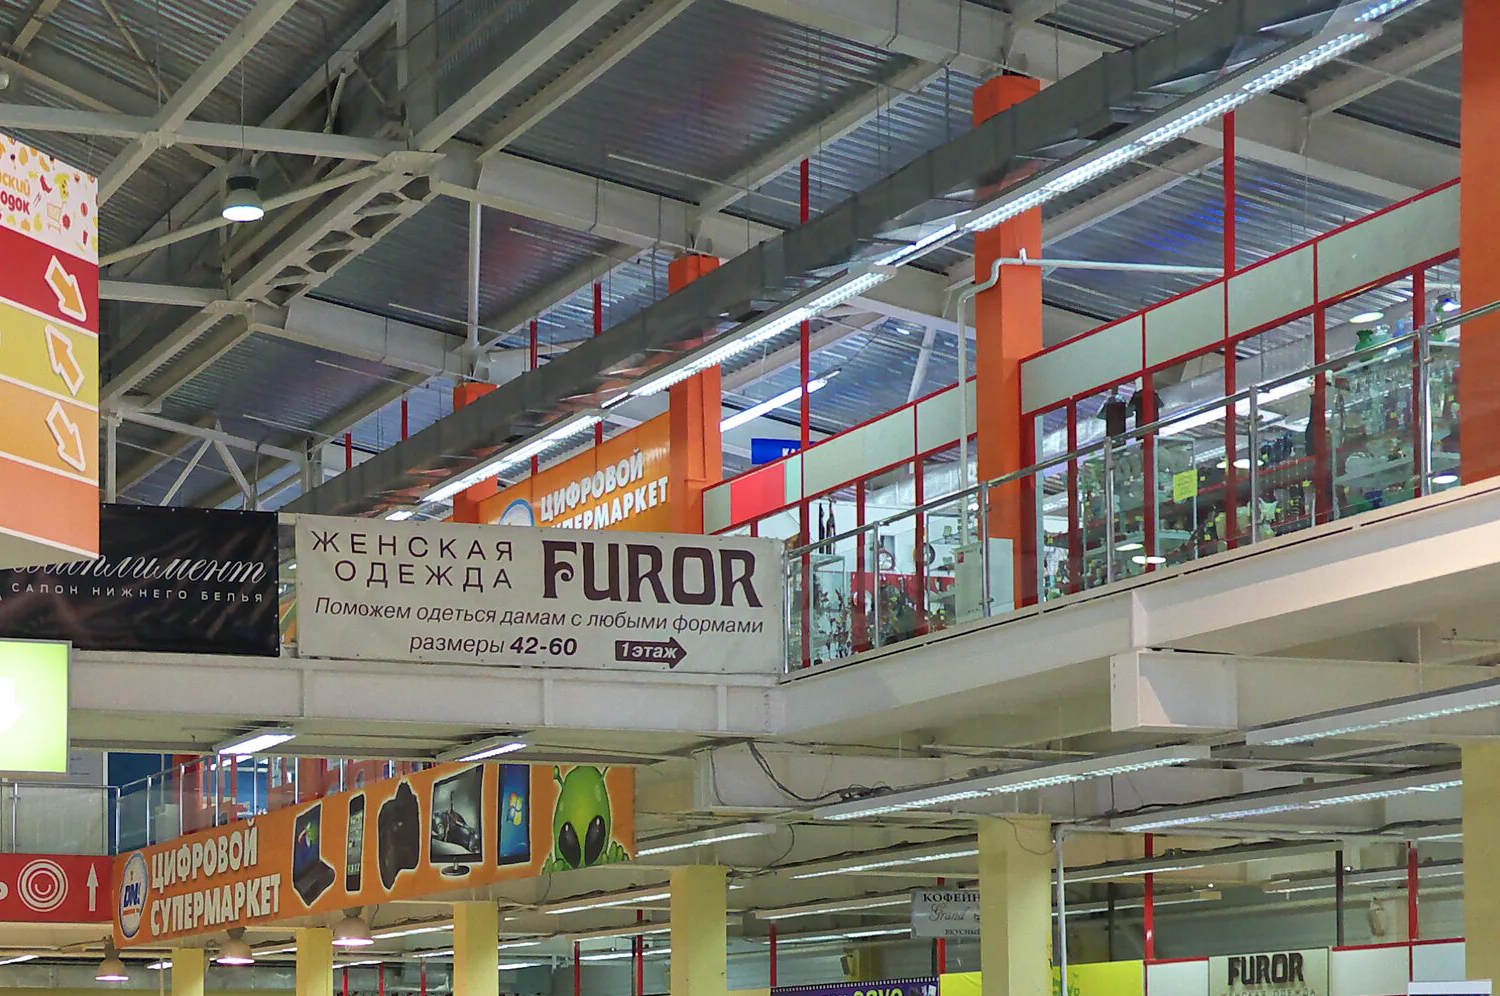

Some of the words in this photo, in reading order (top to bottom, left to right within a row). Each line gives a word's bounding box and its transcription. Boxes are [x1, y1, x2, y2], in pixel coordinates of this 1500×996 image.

[541, 448, 645, 522] ЦИФРОВОЙ
[311, 530, 514, 563] ЖЕНСКАЯ
[334, 559, 513, 593] ОДЕЖДА
[541, 539, 764, 609] FUROR
[11, 582, 79, 595] САЛОН
[92, 586, 188, 600] НИЖНЕГО
[201, 591, 263, 603] БЕЛЬЯ
[315, 597, 411, 620] Поможем
[416, 605, 497, 624] одеться
[500, 610, 566, 629] дамам
[571, 614, 583, 626] с
[586, 612, 667, 631] любыми
[672, 614, 764, 636] формами
[409, 635, 505, 656] размеры
[509, 636, 578, 657] 42-60
[150, 818, 259, 894] ЦИФРОВОЙ
[150, 873, 281, 937] СУПЕРМАРКЕТ
[1227, 952, 1304, 986] FUROR
